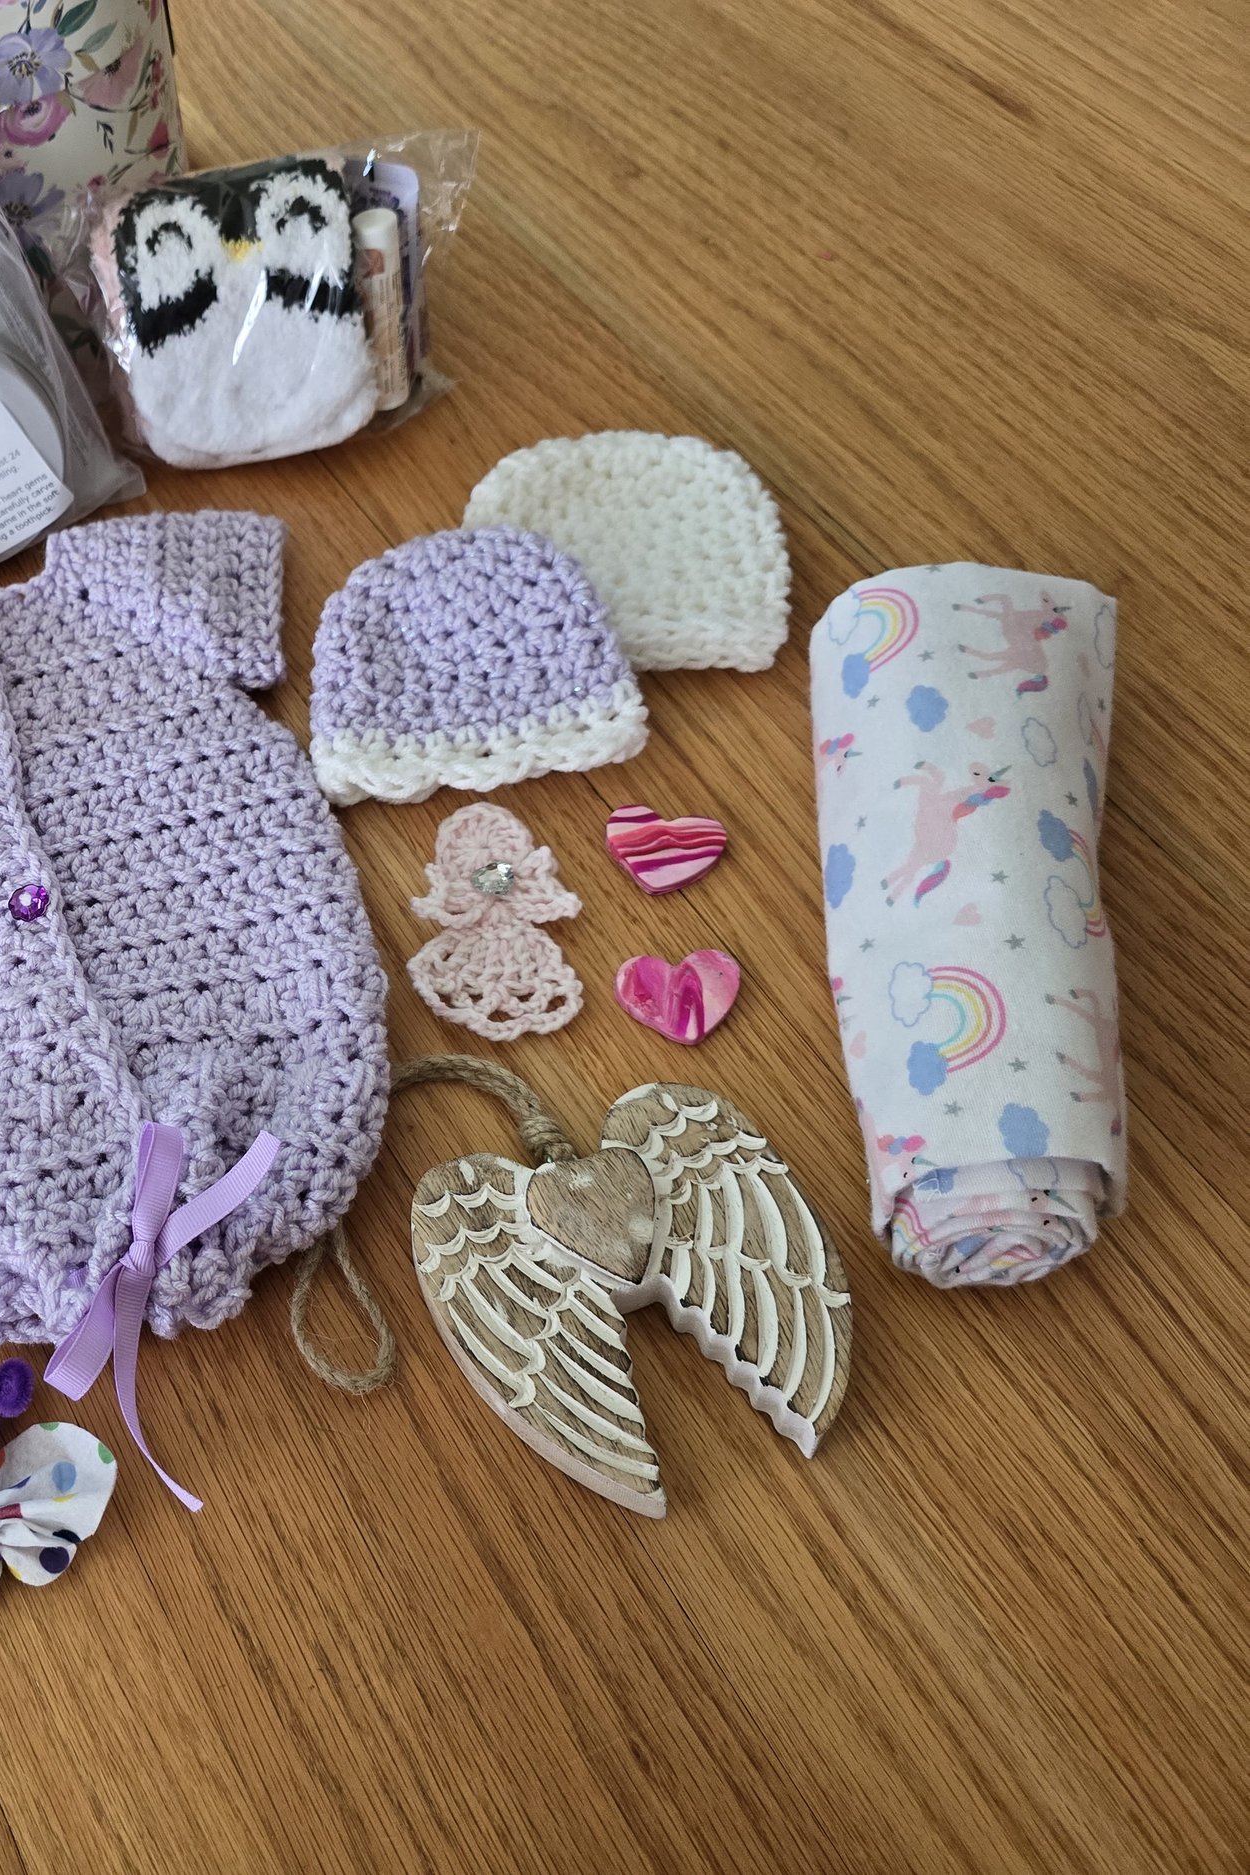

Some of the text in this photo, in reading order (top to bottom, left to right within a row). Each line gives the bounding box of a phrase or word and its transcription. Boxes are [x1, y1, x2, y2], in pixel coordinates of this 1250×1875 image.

[8, 448, 20, 460] 24
[0, 486, 23, 502] heart
[24, 473, 47, 490] gems
[30, 481, 54, 497] carve
[16, 509, 27, 518] in
[26, 500, 41, 512] the
[42, 489, 59, 503] soft
